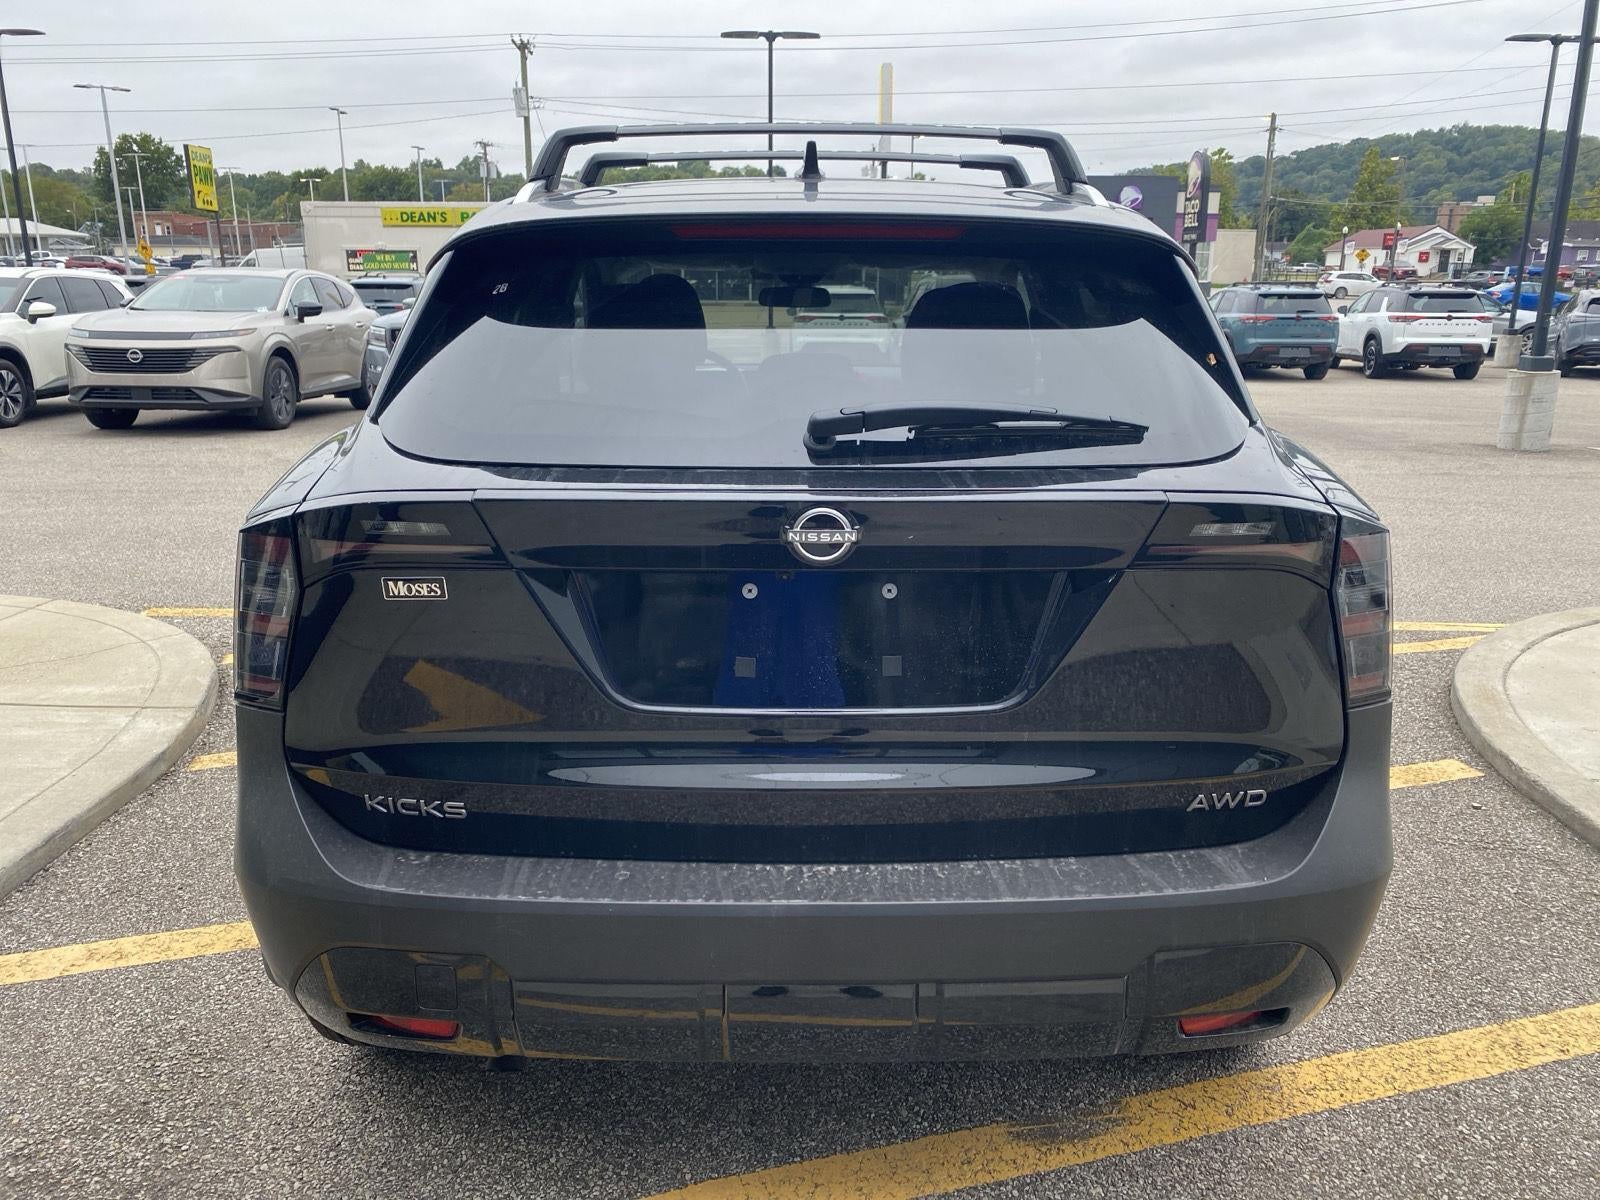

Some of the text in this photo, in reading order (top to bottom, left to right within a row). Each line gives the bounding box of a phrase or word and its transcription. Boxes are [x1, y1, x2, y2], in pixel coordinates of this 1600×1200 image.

[193, 165, 213, 187] PAWN
[1185, 199, 1200, 214] TACO
[400, 211, 447, 223] DEAN'S
[1184, 213, 1199, 228] BELL
[789, 532, 856, 542] NISSAN
[387, 581, 441, 596] MOSES
[364, 794, 467, 819] KICKS
[1186, 789, 1267, 812] AWD
